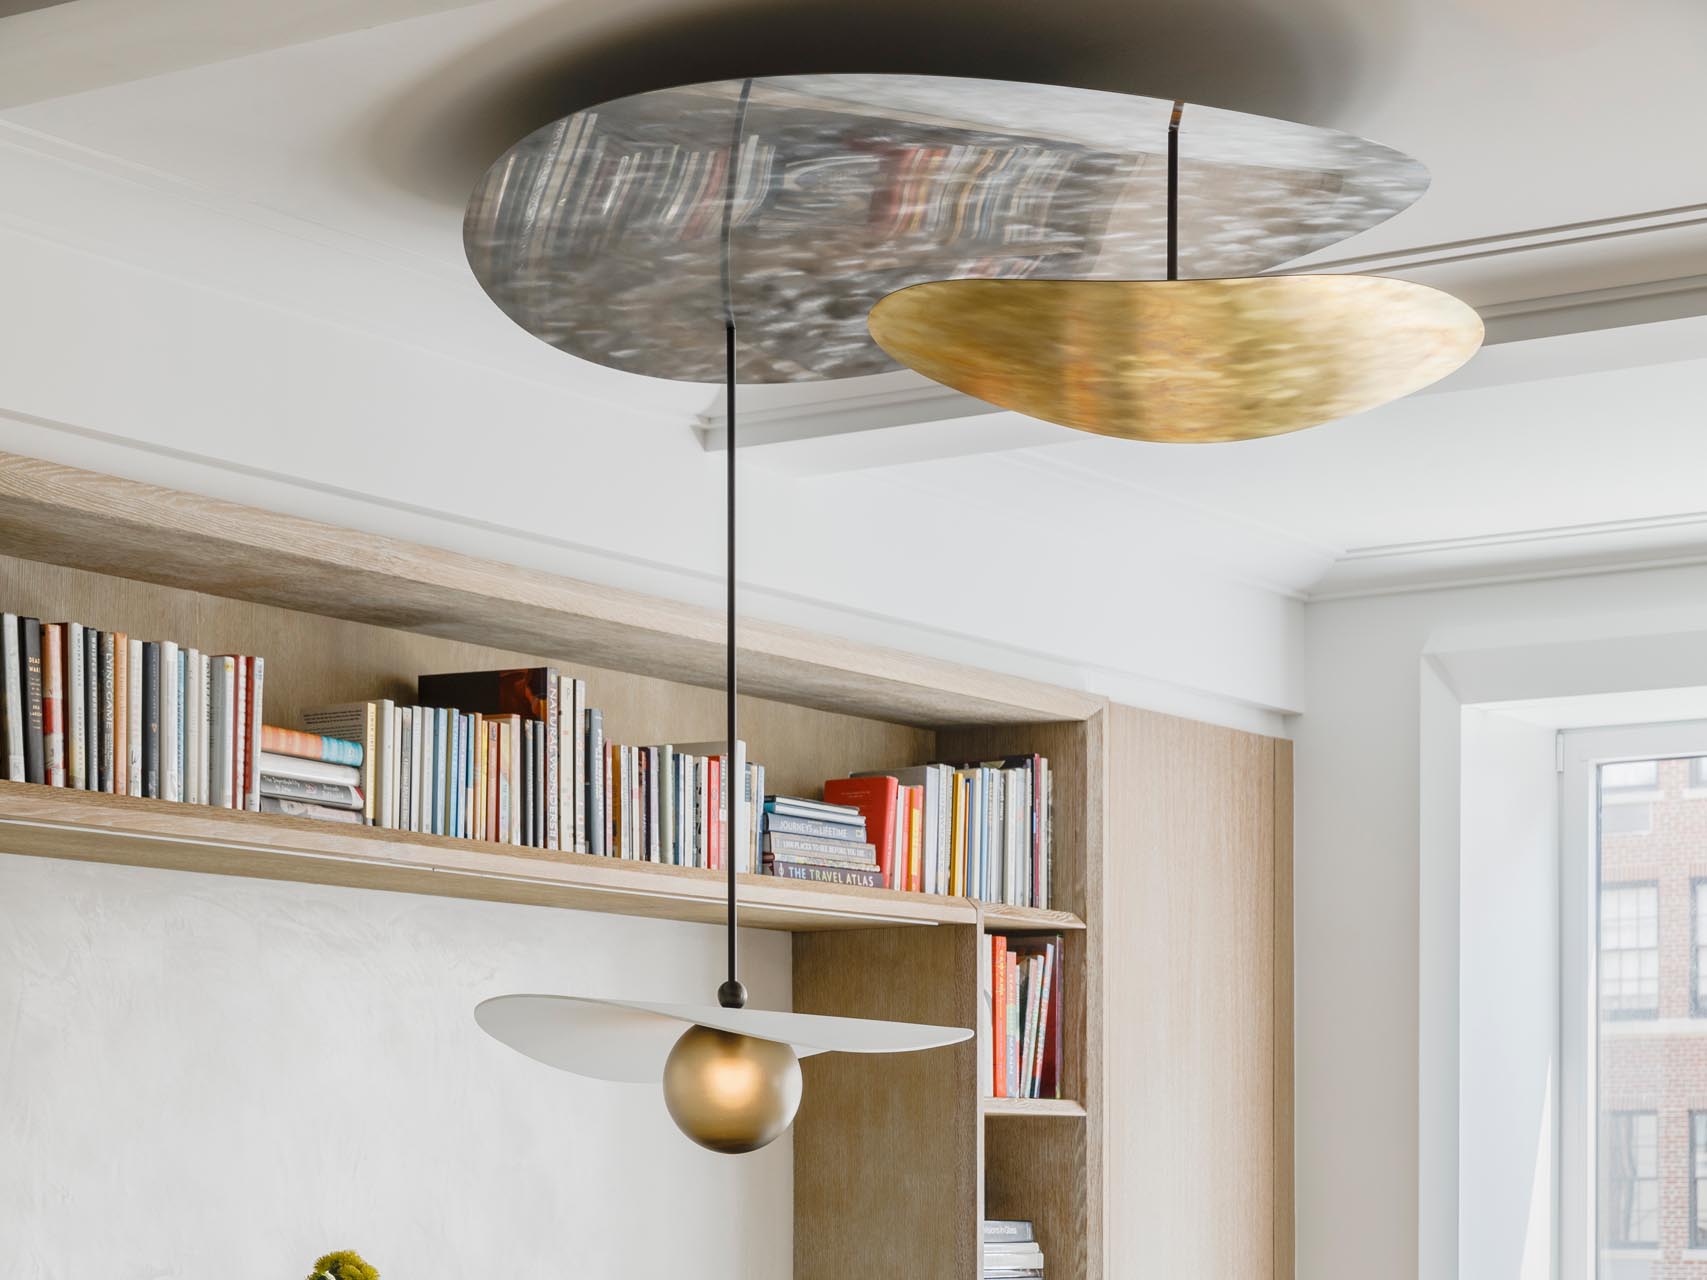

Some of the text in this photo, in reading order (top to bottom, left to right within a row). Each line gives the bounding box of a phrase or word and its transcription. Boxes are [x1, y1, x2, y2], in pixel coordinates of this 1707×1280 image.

[105, 652, 113, 689] LYING
[105, 691, 113, 729] GAME
[549, 686, 558, 753] NATURAL
[549, 755, 558, 830] WONDERS
[780, 819, 814, 833] JOURNEYS
[819, 824, 848, 837] LIFETIME
[788, 866, 875, 887] THE TRAVEL ATLAS
